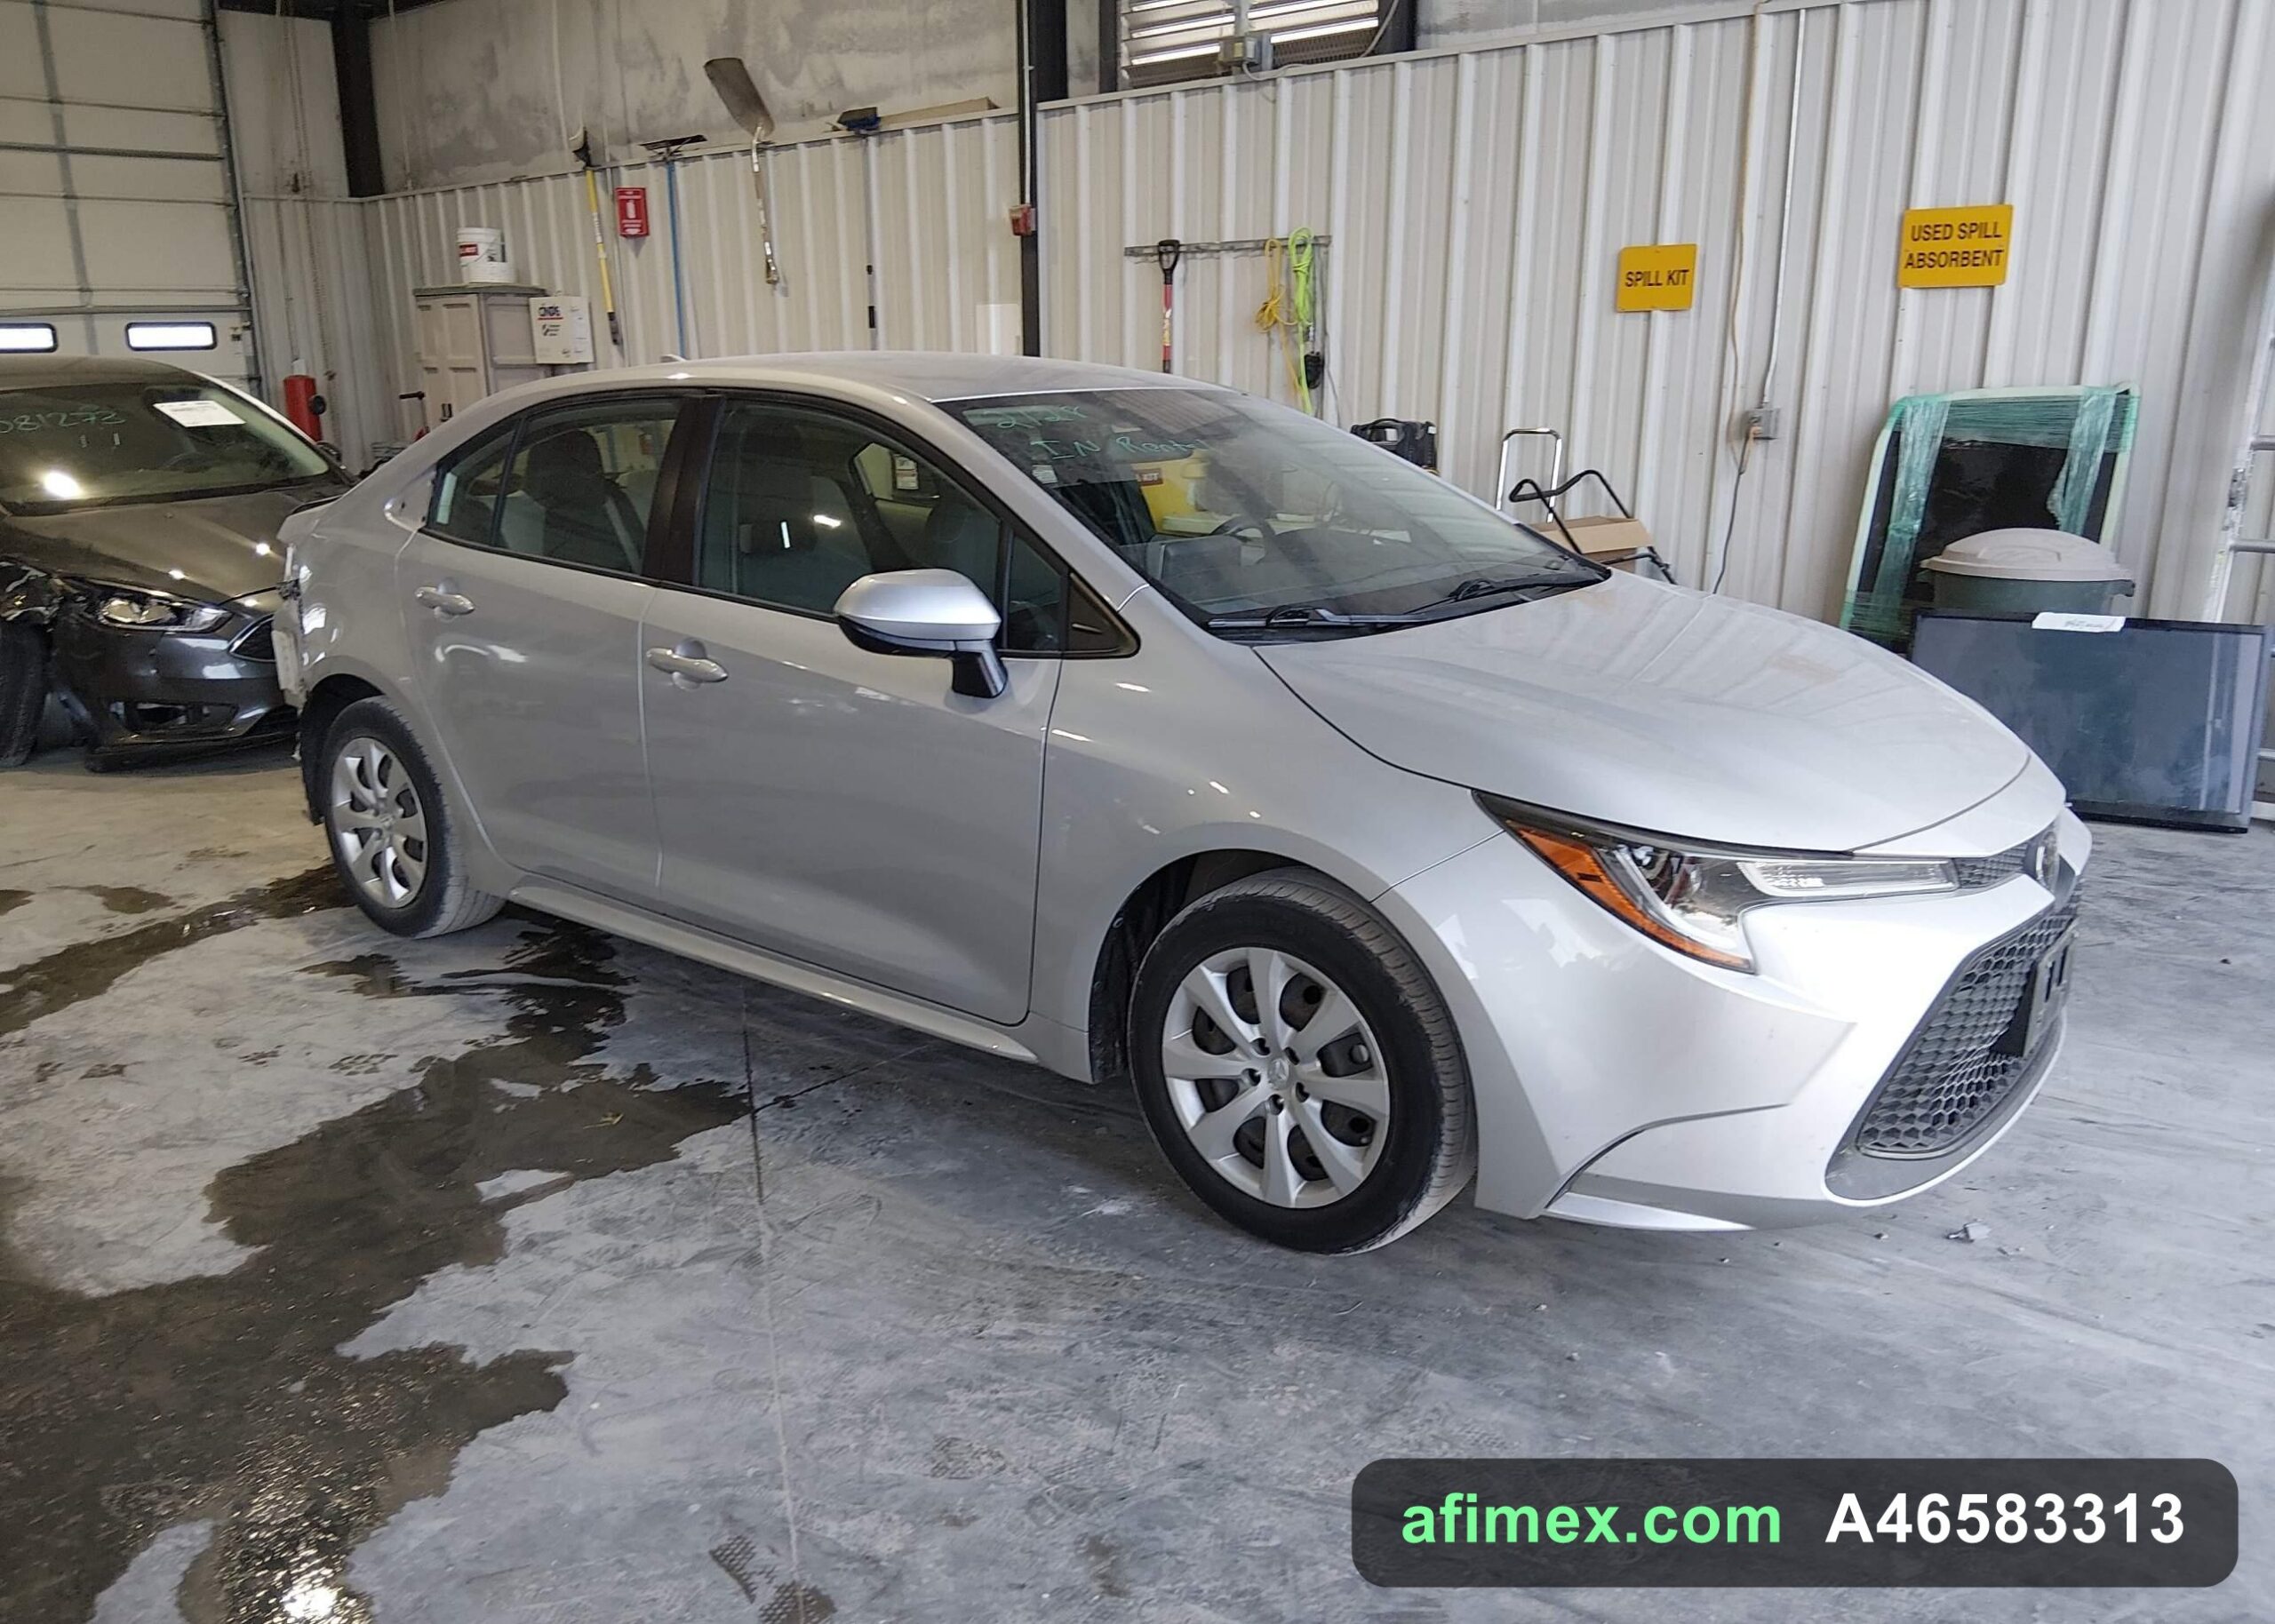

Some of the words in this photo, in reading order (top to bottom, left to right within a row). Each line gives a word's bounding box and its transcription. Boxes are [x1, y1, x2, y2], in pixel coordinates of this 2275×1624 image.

[1911, 223, 1953, 242] USED
[1957, 221, 2003, 240] SPILL
[1904, 250, 2005, 269] ABSORBENT
[1624, 270, 1663, 288] SPILL
[1666, 269, 1690, 286] KIT
[1029, 440, 1101, 460] IN
